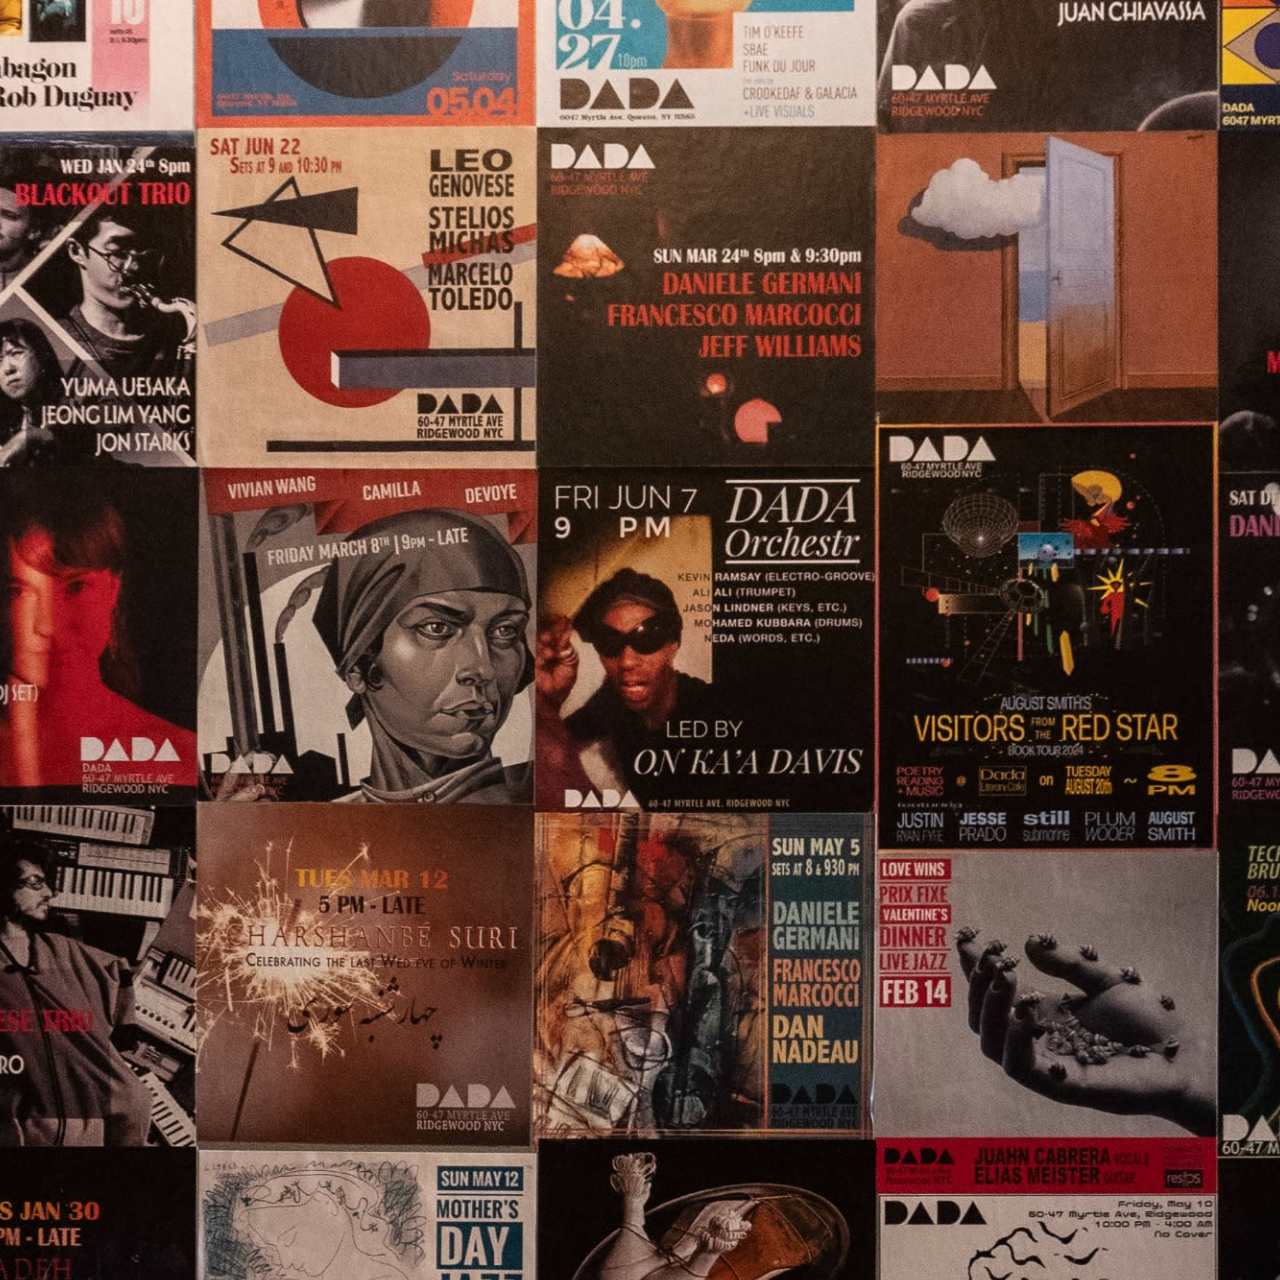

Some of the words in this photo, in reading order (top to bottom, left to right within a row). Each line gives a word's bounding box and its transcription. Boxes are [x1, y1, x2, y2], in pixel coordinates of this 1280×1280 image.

[743, 25, 760, 39] TIM
[763, 25, 804, 39] O'KEEFE
[42, 86, 137, 113] Duguay
[559, 78, 694, 109] DADA
[1222, 115, 1248, 125] 6047
[210, 139, 239, 155] SAT
[245, 139, 275, 155] JUN
[281, 138, 300, 155] 22
[430, 149, 514, 172] LEO
[15, 183, 130, 206] BLACKOUT
[139, 183, 191, 206] TRIO
[430, 174, 514, 198] GENOVESE
[430, 207, 514, 229] STELIOS
[430, 232, 514, 253] MICHAS
[654, 249, 683, 265] SUN
[688, 249, 717, 265] MAR
[722, 248, 749, 264] 24th
[753, 248, 785, 268] 8pm
[790, 248, 801, 263] &
[805, 248, 862, 268] 9:30pm
[429, 265, 514, 286] MARCELO
[663, 273, 754, 295] DANIELE
[762, 273, 862, 295] GERMANI
[429, 289, 513, 311] TOLEDO
[608, 304, 737, 327] FRANCESCO
[745, 304, 862, 327] MARCOCCI
[699, 336, 748, 359] JEFF
[757, 335, 862, 358] WILLIAMS
[61, 377, 117, 397] YUMA
[121, 377, 191, 397] UESAKA
[417, 394, 504, 414] DADA
[96, 432, 128, 453] JON
[133, 432, 191, 453] STARKS
[417, 428, 480, 439] RIDGEWOOD
[484, 428, 504, 439] NYC
[228, 480, 272, 499] VIVIAN
[275, 476, 317, 495] WANG
[363, 481, 421, 501] CAMILLA
[465, 484, 517, 504] DEVOYE
[725, 486, 857, 524] DADA
[725, 528, 861, 559] Orchestr
[666, 720, 708, 739] LED
[714, 720, 742, 738] BY
[633, 749, 679, 775] ON
[690, 748, 758, 775] KA'A
[764, 748, 863, 775] DAVIS
[959, 812, 1006, 826] JESSE
[1147, 811, 1195, 825] AUGUST
[959, 826, 1007, 841] PRADO
[1147, 826, 1196, 841] SMITH
[882, 979, 920, 1004] FEB
[923, 979, 948, 1004] 14
[773, 1016, 824, 1039] DAN
[773, 1040, 859, 1064] NADEAU
[436, 1200, 519, 1219] MOTHER'S
[440, 1227, 508, 1267] DAY
